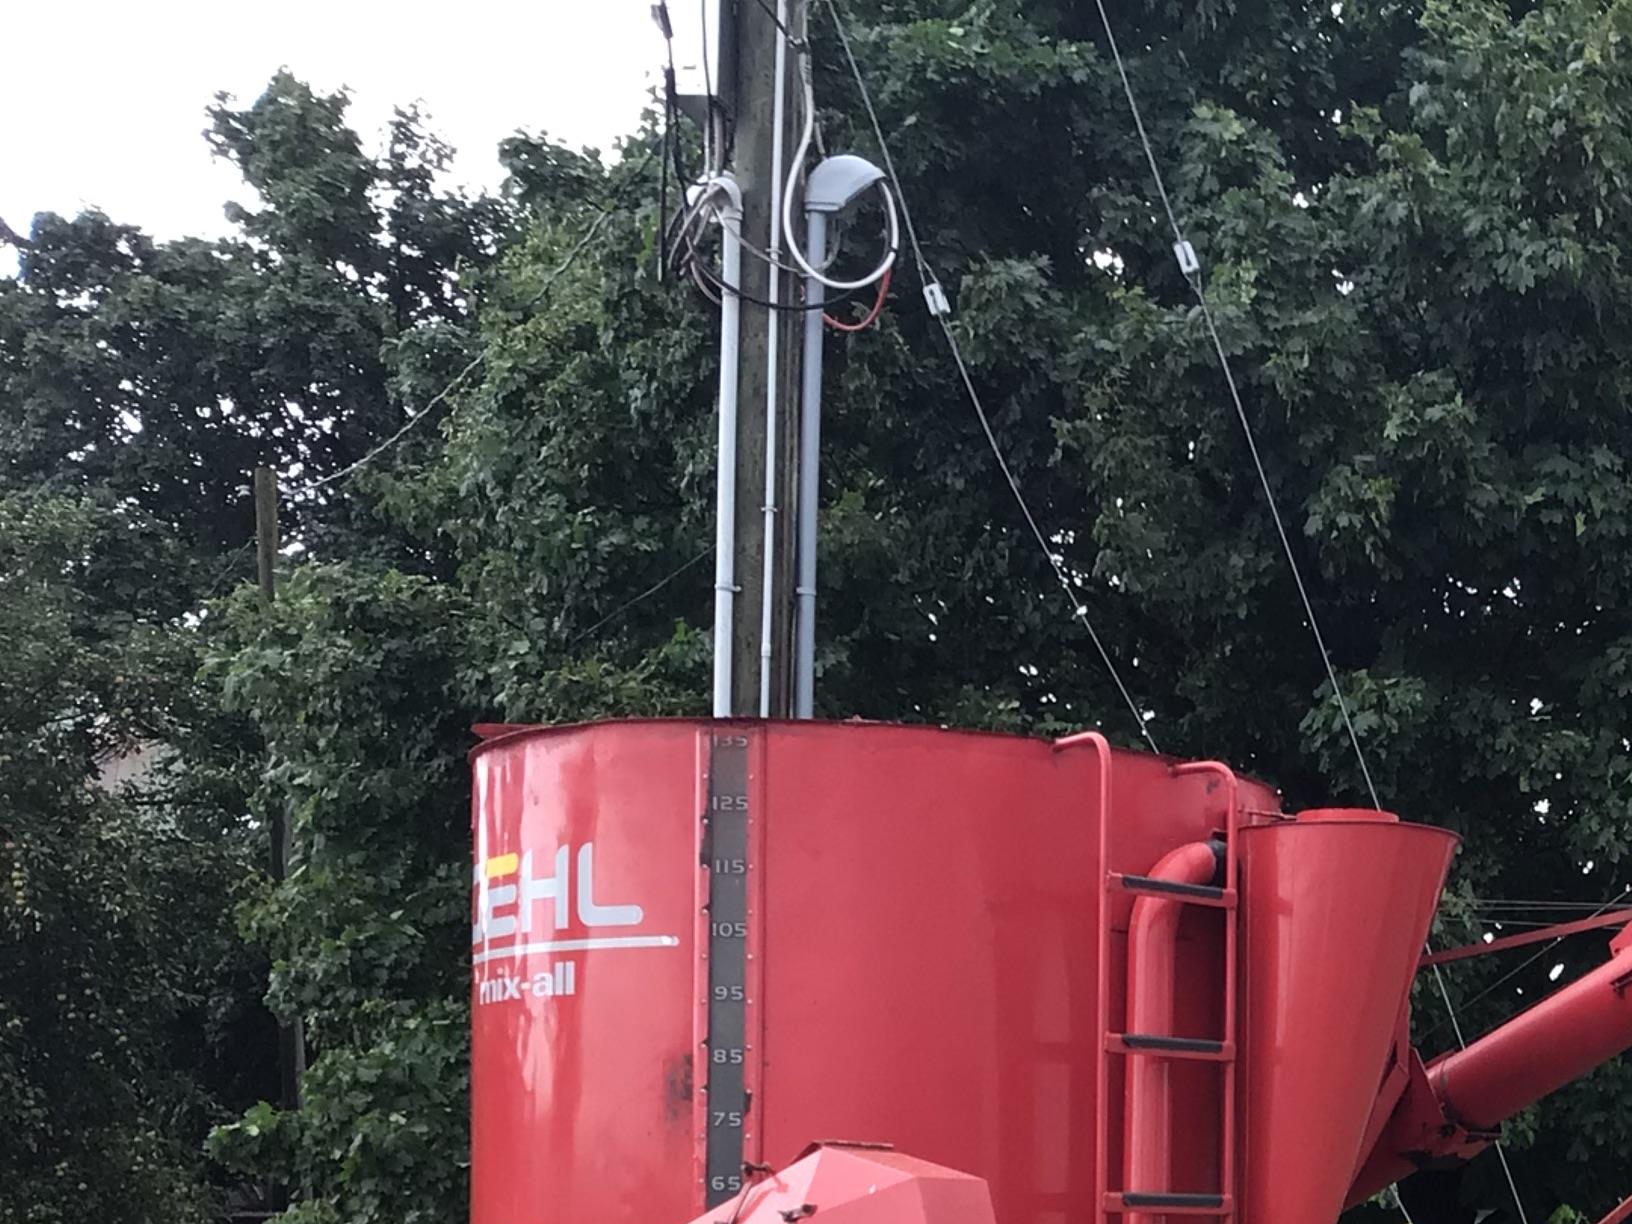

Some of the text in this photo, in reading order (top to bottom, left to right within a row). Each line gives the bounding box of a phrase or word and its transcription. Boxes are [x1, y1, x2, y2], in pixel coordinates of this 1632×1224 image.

[713, 735, 748, 747] 135
[712, 796, 748, 811] 125
[715, 859, 745, 874] 115
[473, 842, 643, 944] EHL
[712, 922, 747, 937] 105
[480, 960, 575, 1005] mix-all
[714, 986, 744, 1000] 95
[712, 1049, 743, 1064] 85
[713, 1112, 742, 1126] 75
[711, 1176, 741, 1191] 65
